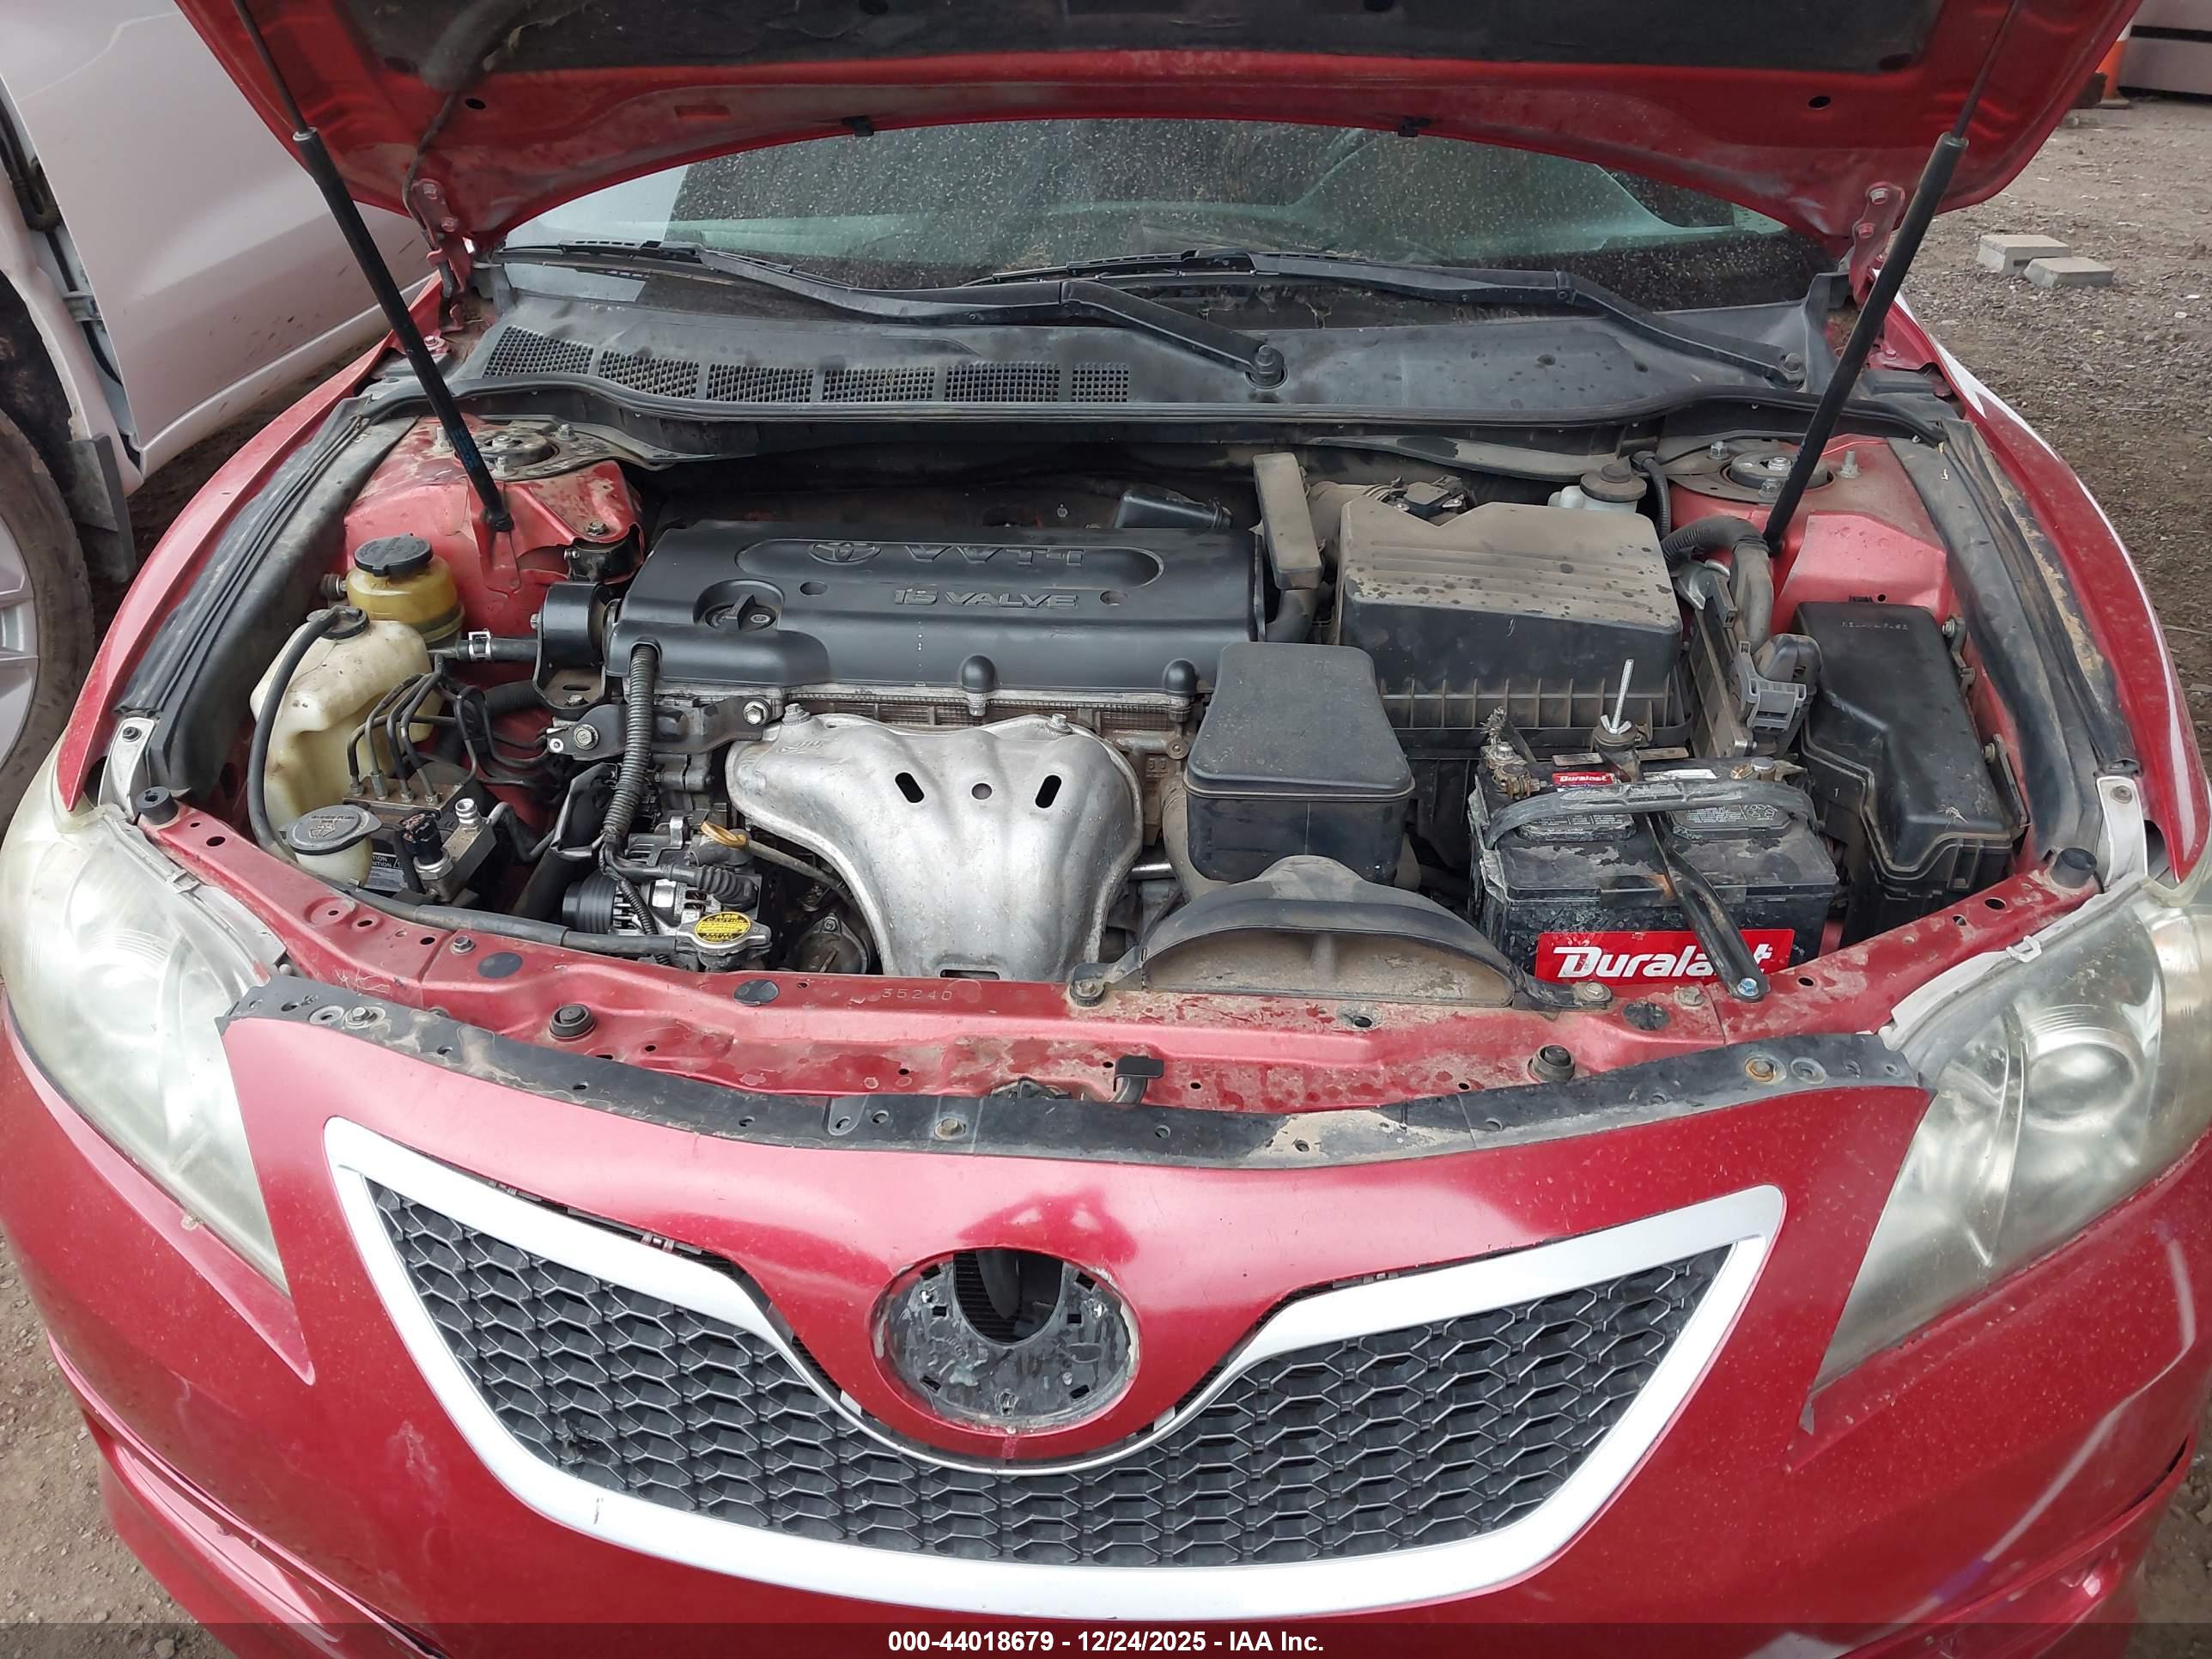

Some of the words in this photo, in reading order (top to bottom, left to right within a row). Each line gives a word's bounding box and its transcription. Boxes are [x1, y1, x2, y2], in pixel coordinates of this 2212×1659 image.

[945, 590, 1079, 609] VALVE
[1558, 775, 1608, 785] Duralast
[1553, 943, 1774, 978] Duralat
